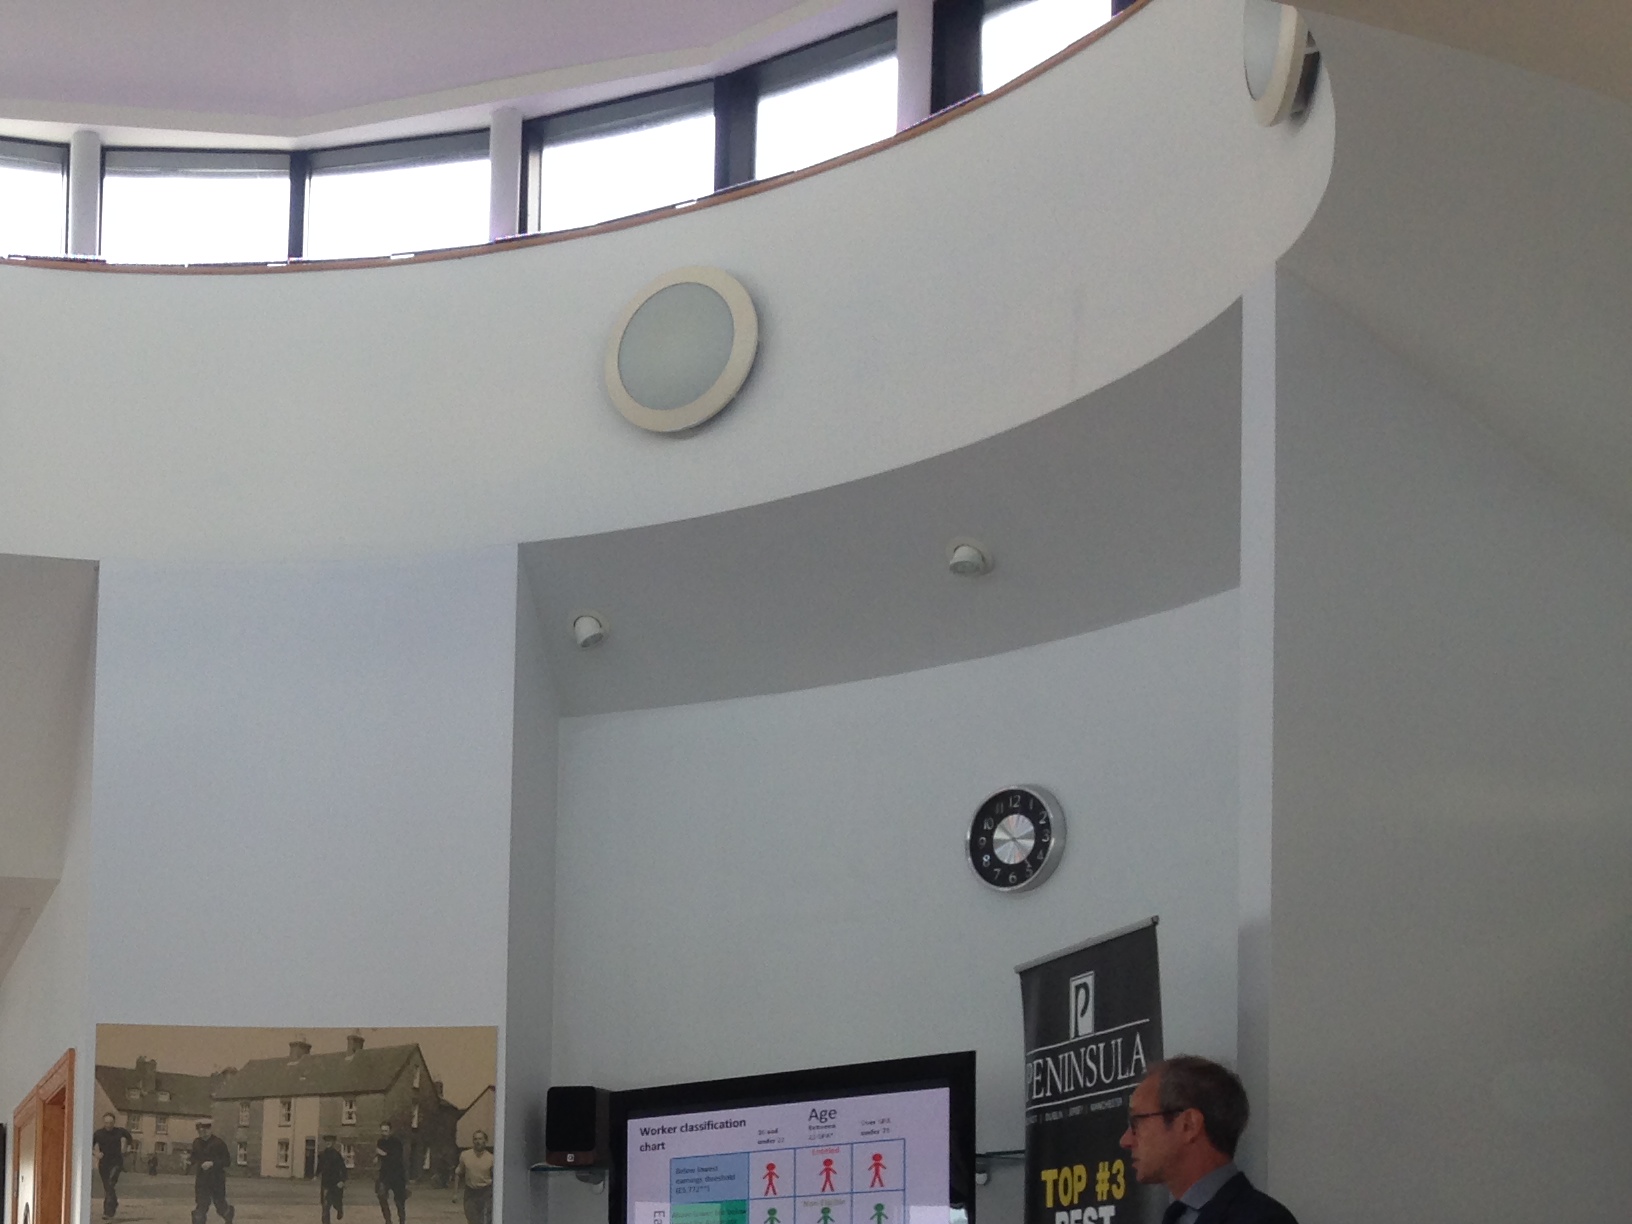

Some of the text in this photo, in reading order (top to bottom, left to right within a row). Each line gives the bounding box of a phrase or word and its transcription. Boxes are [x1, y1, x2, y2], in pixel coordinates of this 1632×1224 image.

[995, 802, 1004, 814] 11
[1009, 795, 1021, 808] 12
[983, 817, 994, 830] 10
[1039, 811, 1048, 825] 2
[1042, 829, 1050, 842] 3
[978, 837, 987, 849] 9
[982, 854, 991, 867] 8
[1036, 849, 1044, 860] 4
[993, 868, 1002, 880] 7
[1008, 871, 1017, 884] 6
[808, 1108, 838, 1123] Age
[639, 1118, 747, 1137] Worker classification
[639, 1141, 666, 1152] chart
[1040, 1159, 1126, 1208] TOP #3
